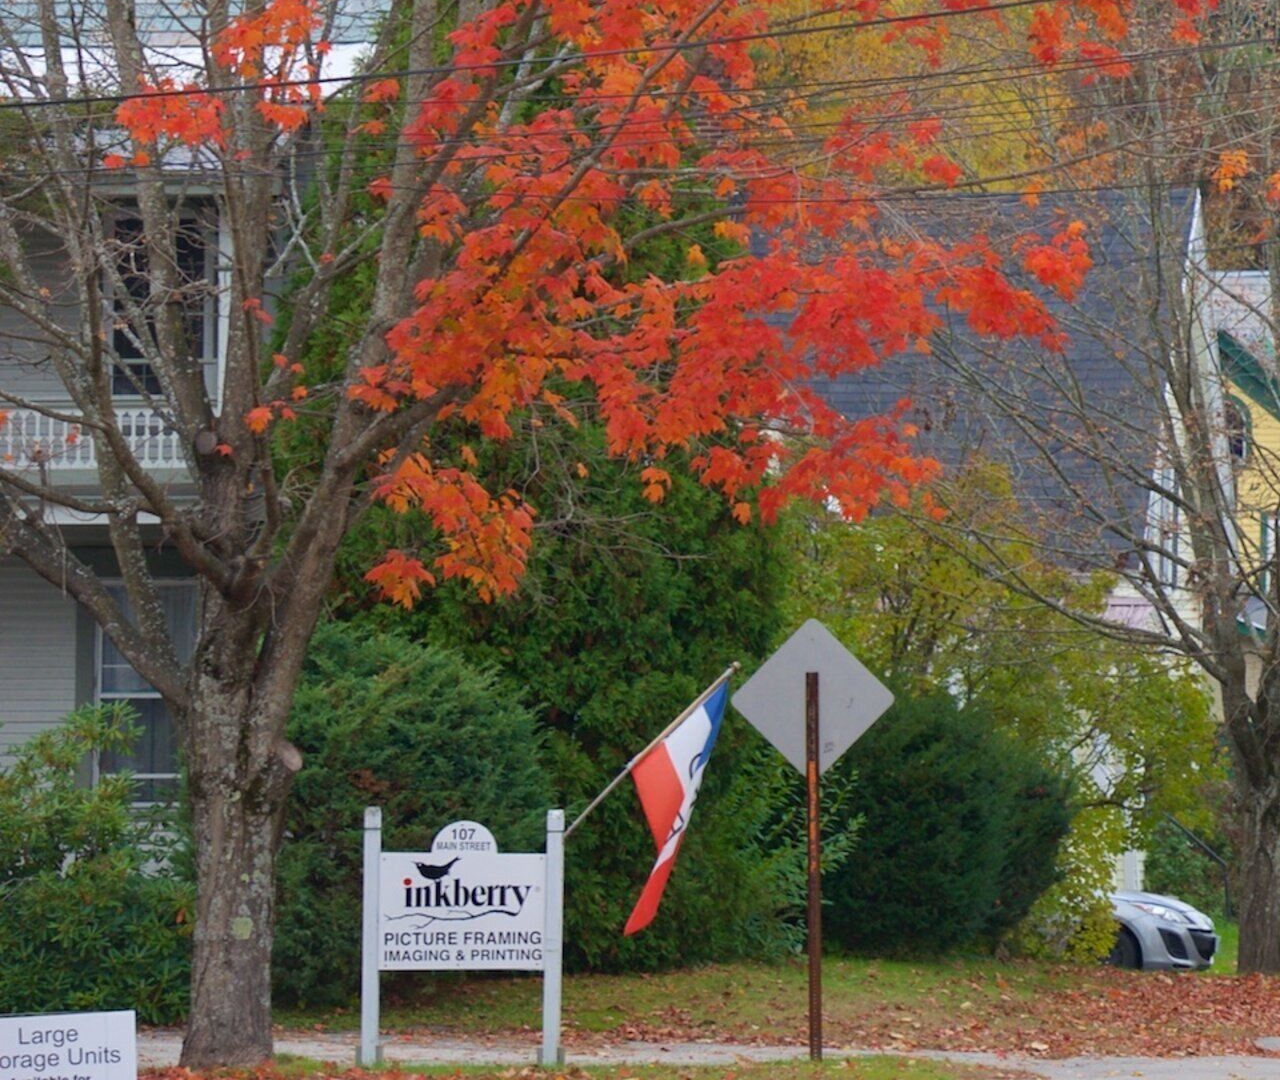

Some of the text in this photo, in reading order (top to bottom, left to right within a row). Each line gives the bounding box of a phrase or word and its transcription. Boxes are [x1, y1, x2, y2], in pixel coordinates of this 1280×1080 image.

[452, 828, 476, 840] 107
[436, 841, 491, 851] MAIN STREET
[403, 877, 533, 911] inkberry
[384, 931, 542, 946] PICTURE FRAMING
[384, 948, 542, 962] IMAGING & PRINTING
[18, 1027, 79, 1047] Large
[68, 1046, 122, 1065] Units
